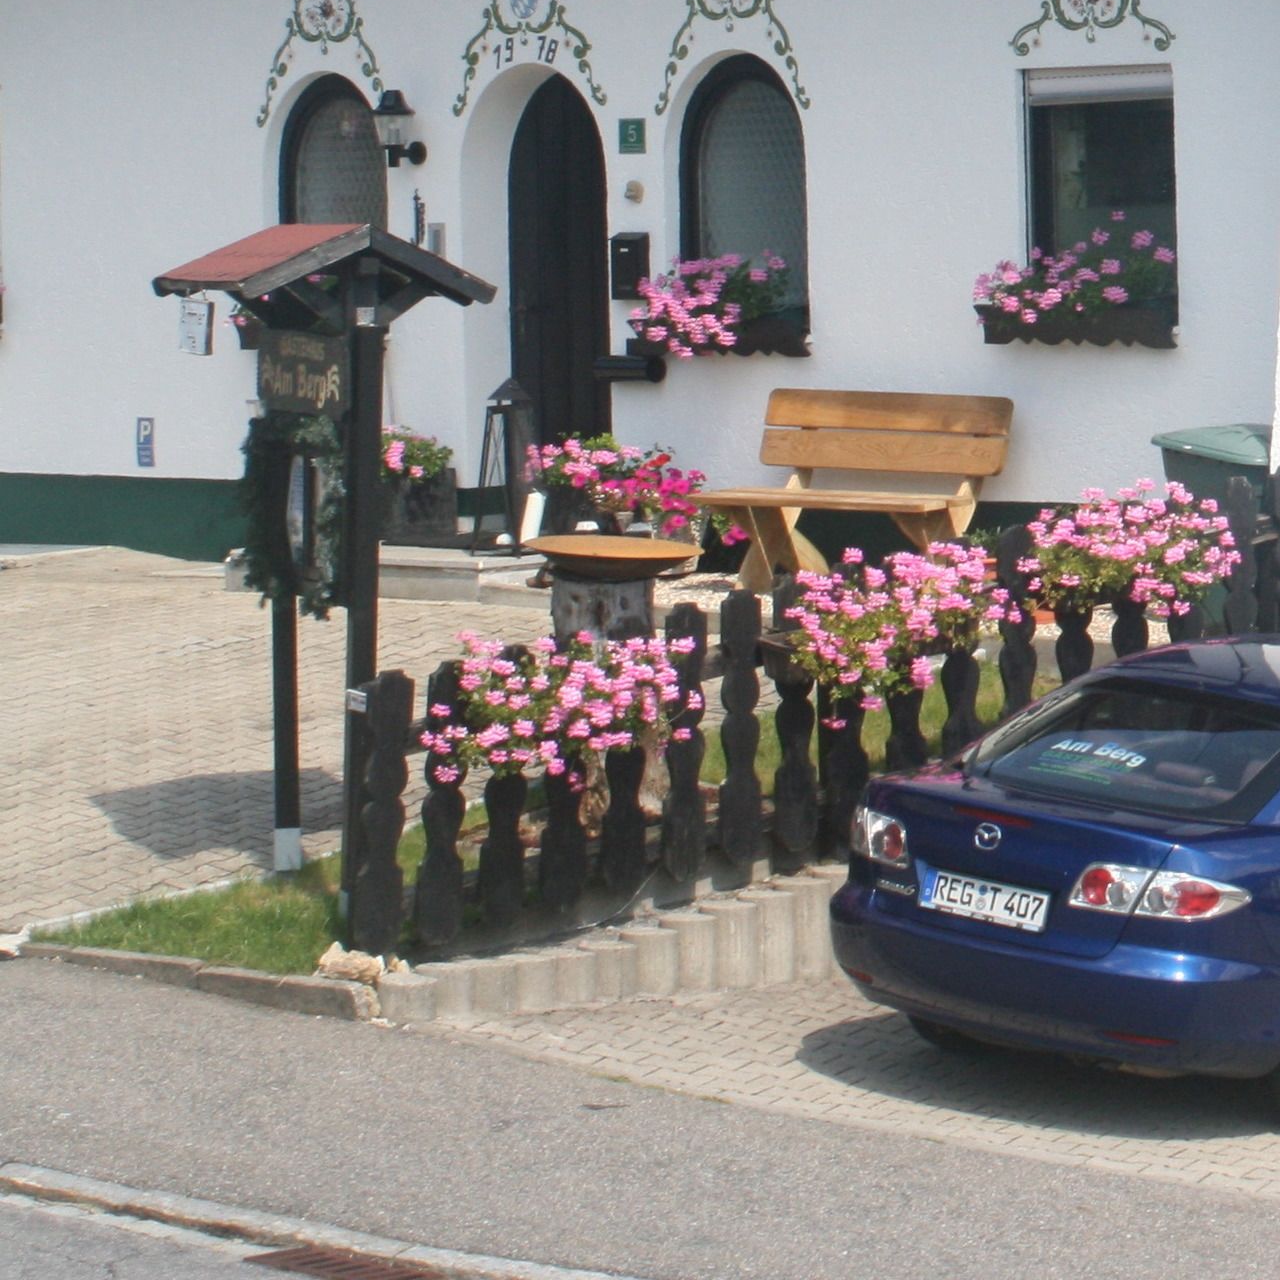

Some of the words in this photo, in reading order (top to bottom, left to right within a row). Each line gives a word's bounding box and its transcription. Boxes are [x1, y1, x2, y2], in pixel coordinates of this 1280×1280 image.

[627, 124, 637, 142] 5
[140, 422, 151, 442] P
[1051, 739, 1093, 752] Am
[1093, 741, 1146, 768] Berg
[933, 876, 974, 907] REG
[990, 887, 1001, 911] T
[1004, 892, 1044, 921] 407
